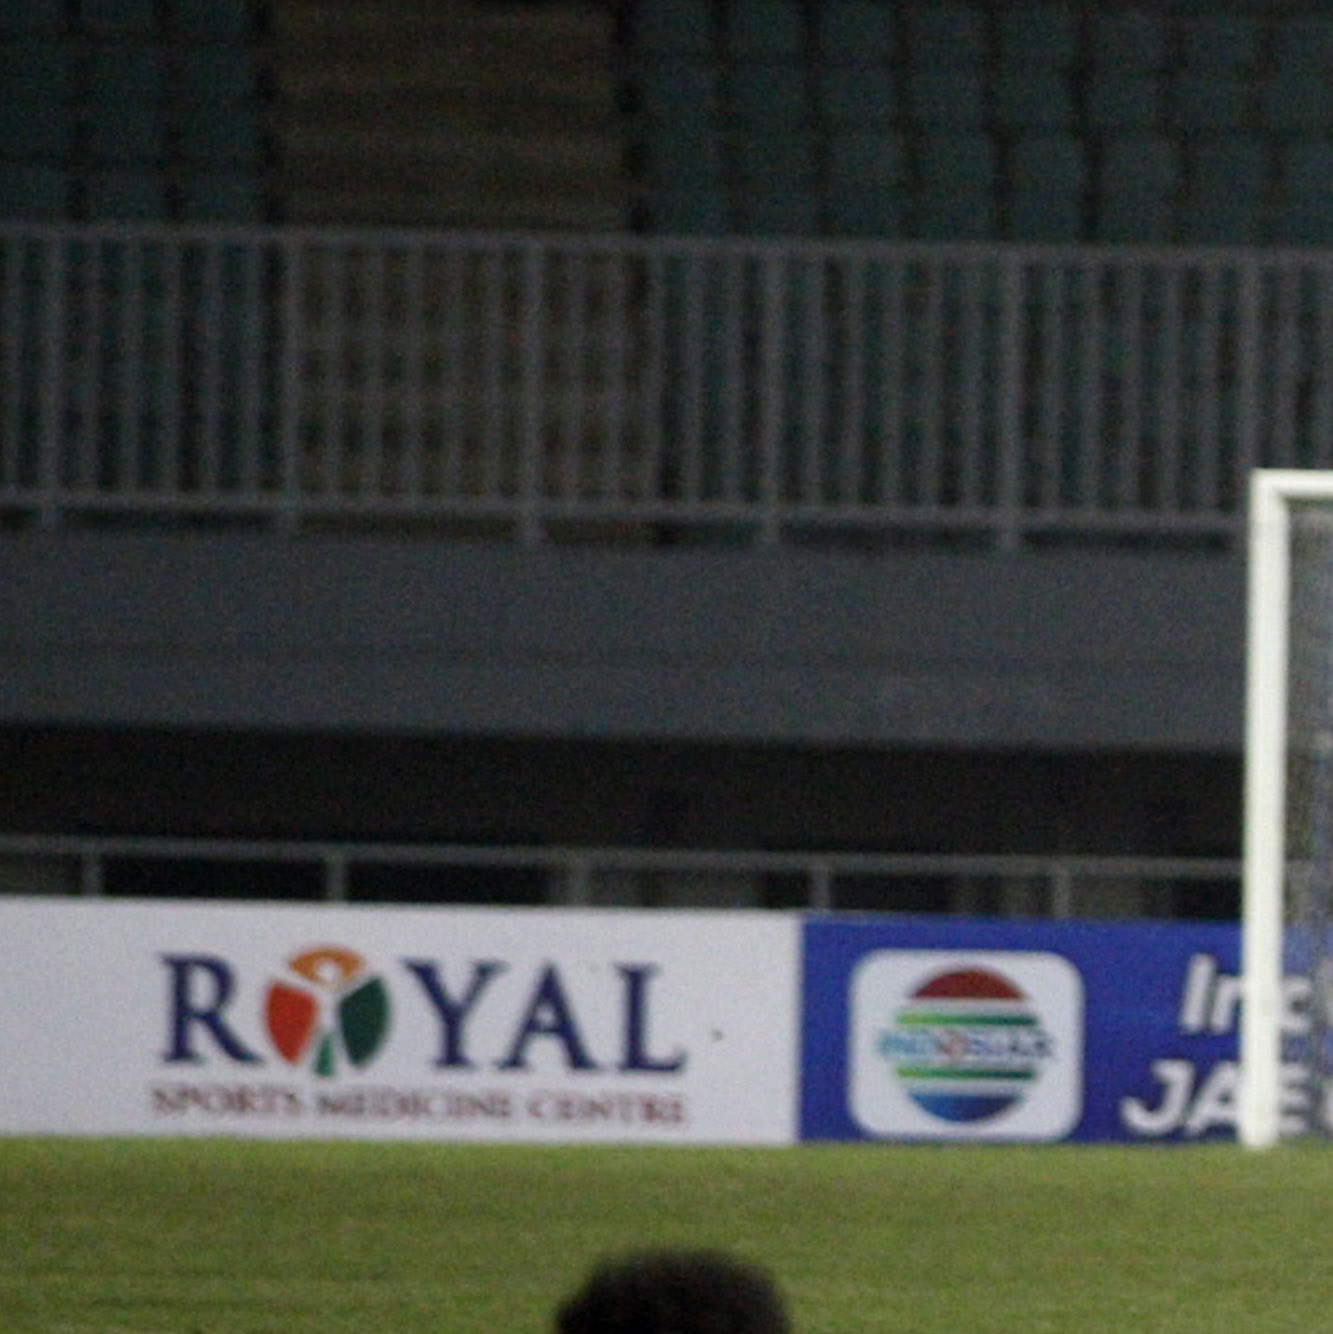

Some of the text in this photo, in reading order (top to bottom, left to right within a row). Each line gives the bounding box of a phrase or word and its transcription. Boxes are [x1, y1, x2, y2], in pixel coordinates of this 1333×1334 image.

[161, 945, 687, 1076] ROYAL
[153, 1084, 688, 1125] SPORTS MEDICINE CENTRE
